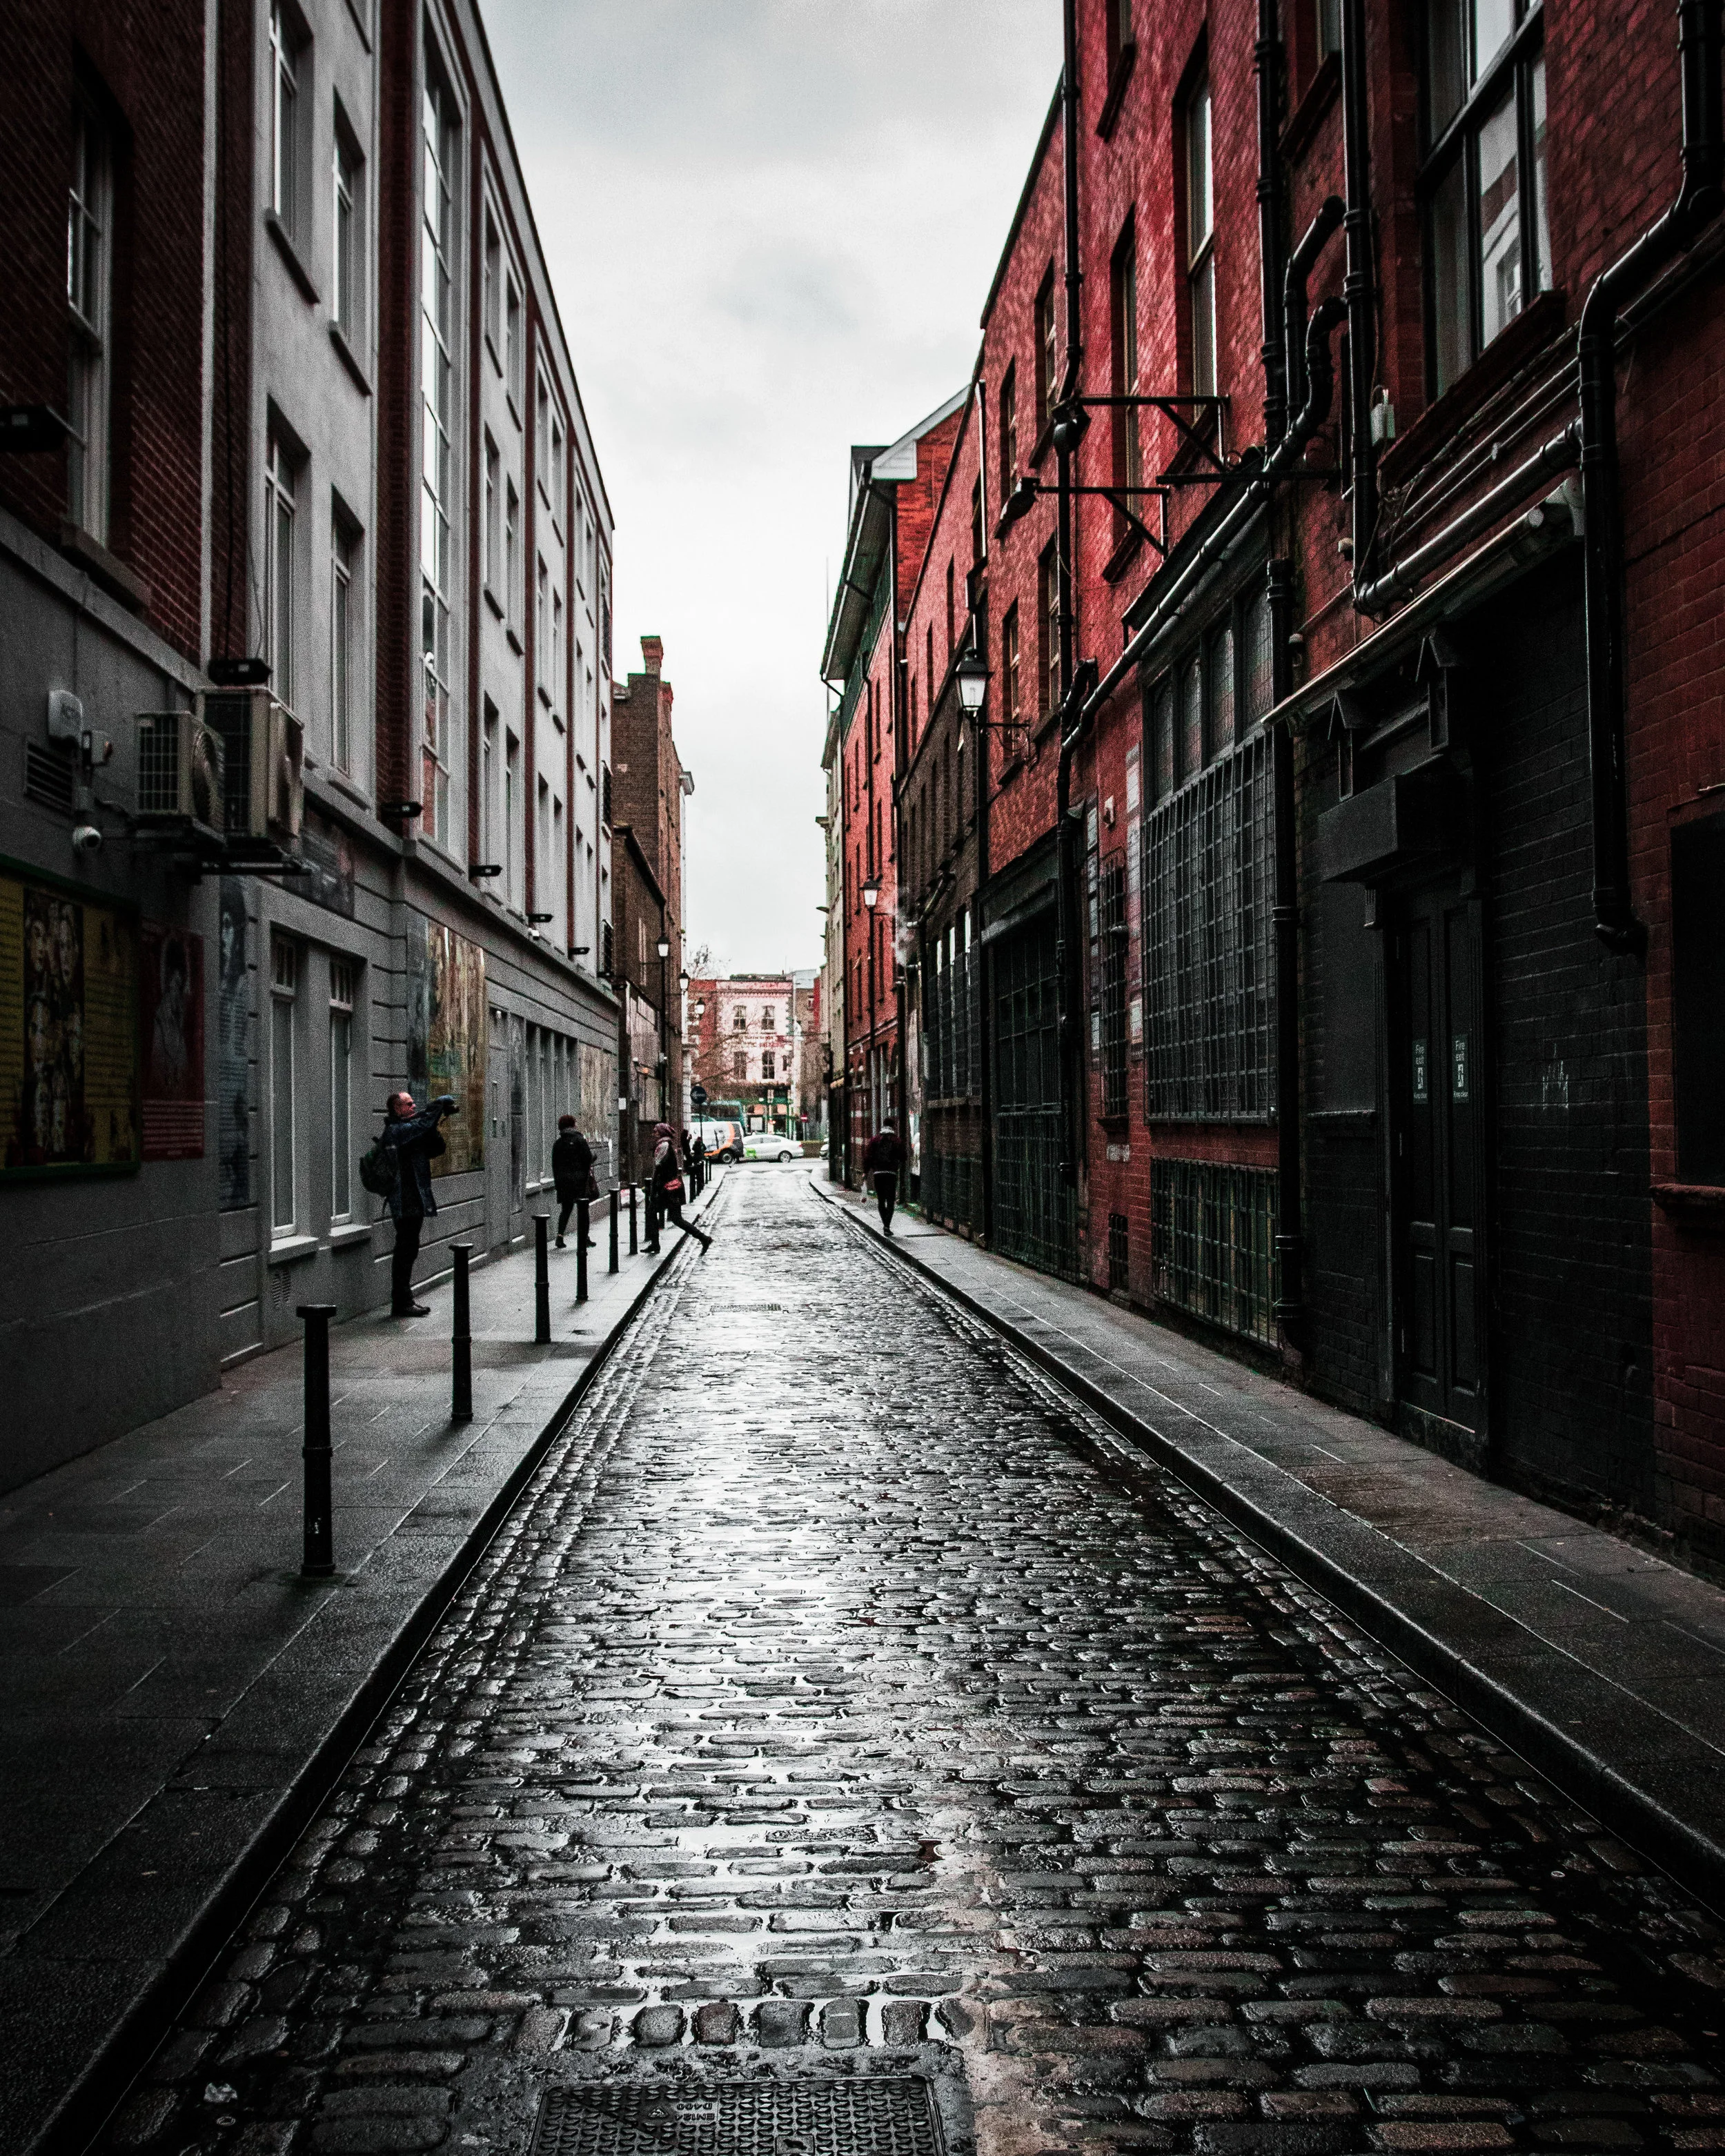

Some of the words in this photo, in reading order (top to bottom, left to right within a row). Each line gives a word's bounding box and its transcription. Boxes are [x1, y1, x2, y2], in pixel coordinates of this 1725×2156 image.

[1415, 1045, 1424, 1054] Fire
[1455, 1040, 1465, 1051] Fire
[1415, 1055, 1424, 1065] exit
[1455, 1051, 1465, 1062] exit
